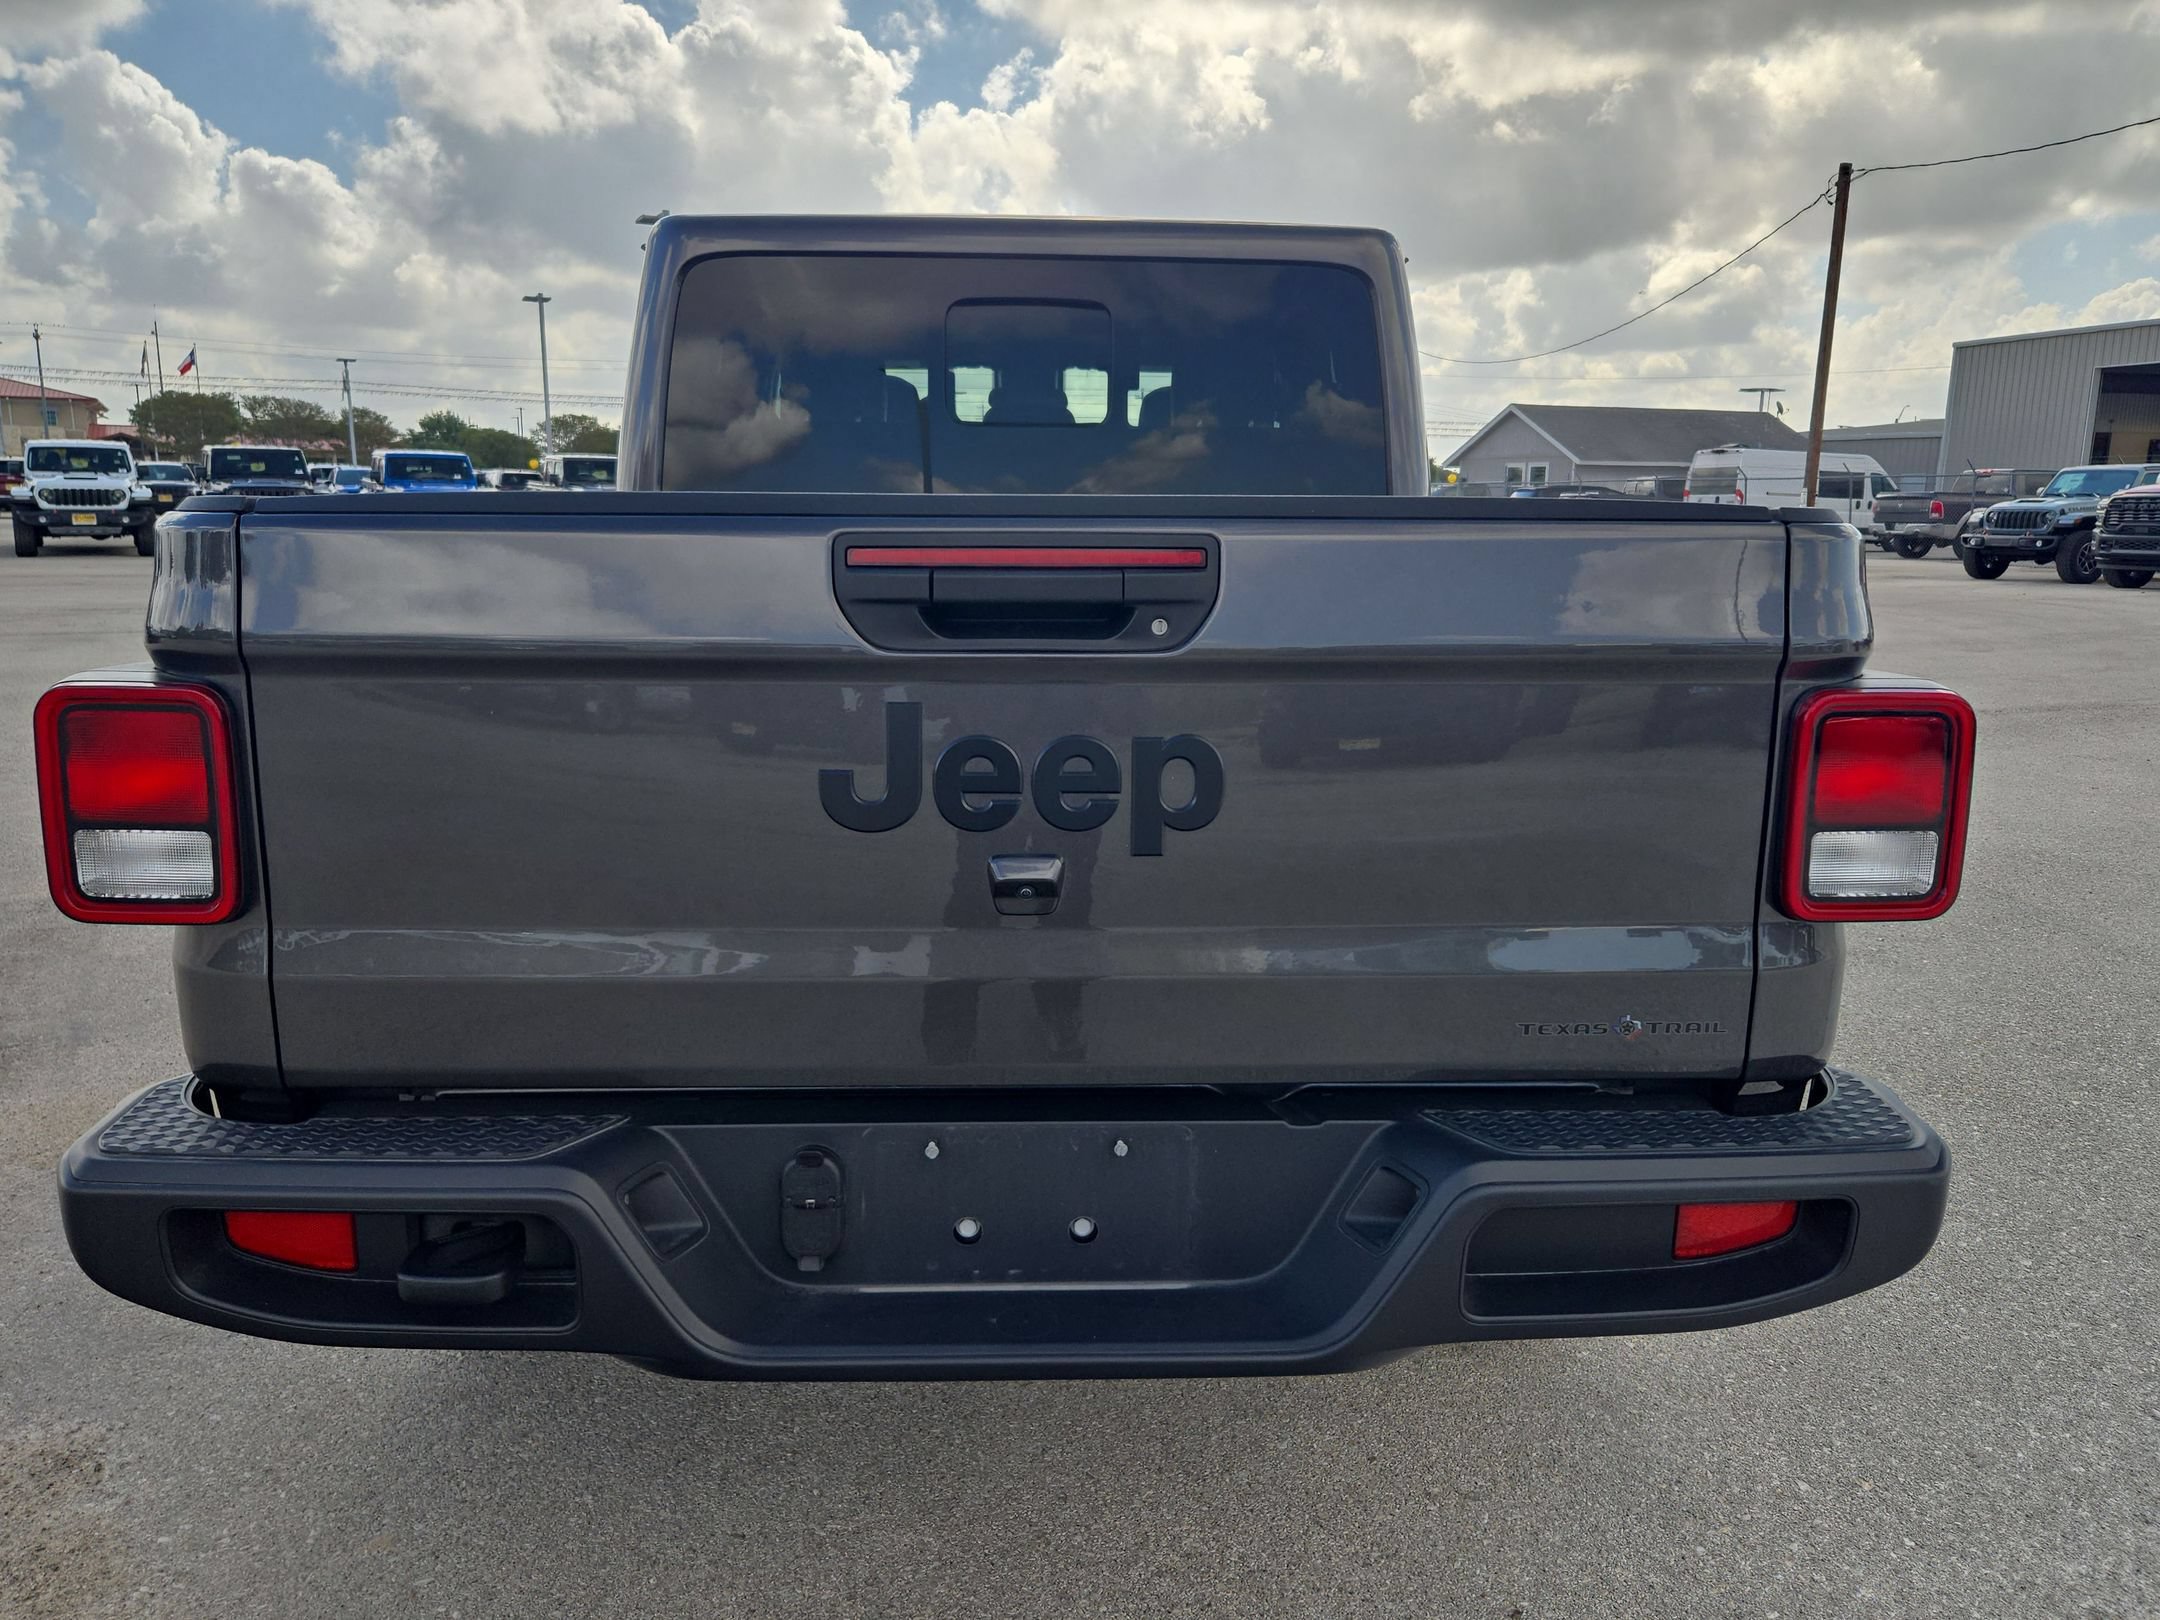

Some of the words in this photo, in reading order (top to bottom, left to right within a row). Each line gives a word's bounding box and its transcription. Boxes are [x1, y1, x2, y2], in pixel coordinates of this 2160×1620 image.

[818, 701, 1225, 857] Jeep
[1517, 1022, 1608, 1036] TEXAS
[1646, 1021, 1728, 1034] TRAIL
